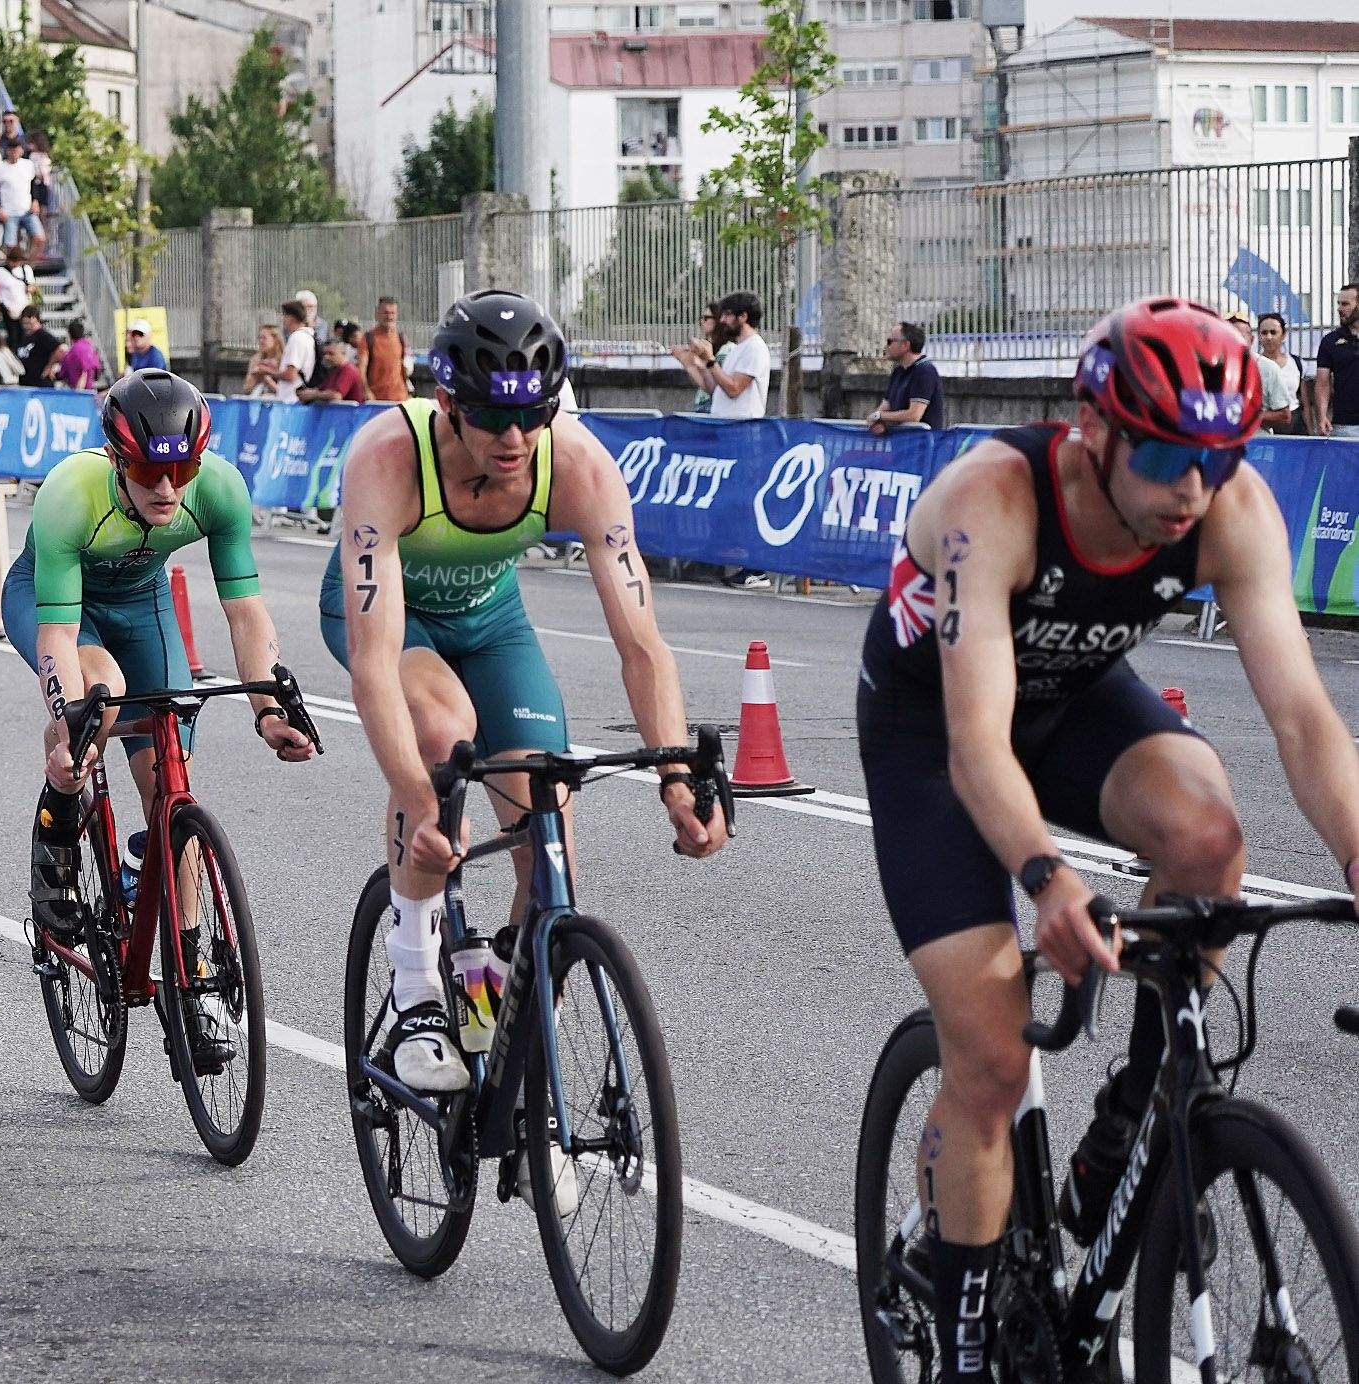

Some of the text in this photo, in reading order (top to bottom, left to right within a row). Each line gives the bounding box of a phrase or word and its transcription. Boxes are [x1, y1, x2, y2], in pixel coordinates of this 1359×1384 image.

[502, 379, 518, 395] 17
[156, 442, 170, 454] 48
[650, 452, 738, 510] NTT
[821, 465, 923, 537] NTT
[356, 554, 378, 613] 17
[402, 556, 515, 587] LANGDON
[617, 551, 645, 608] 17
[941, 568, 960, 646] 14
[1015, 617, 1155, 653] NELSON
[46, 674, 66, 722] 48
